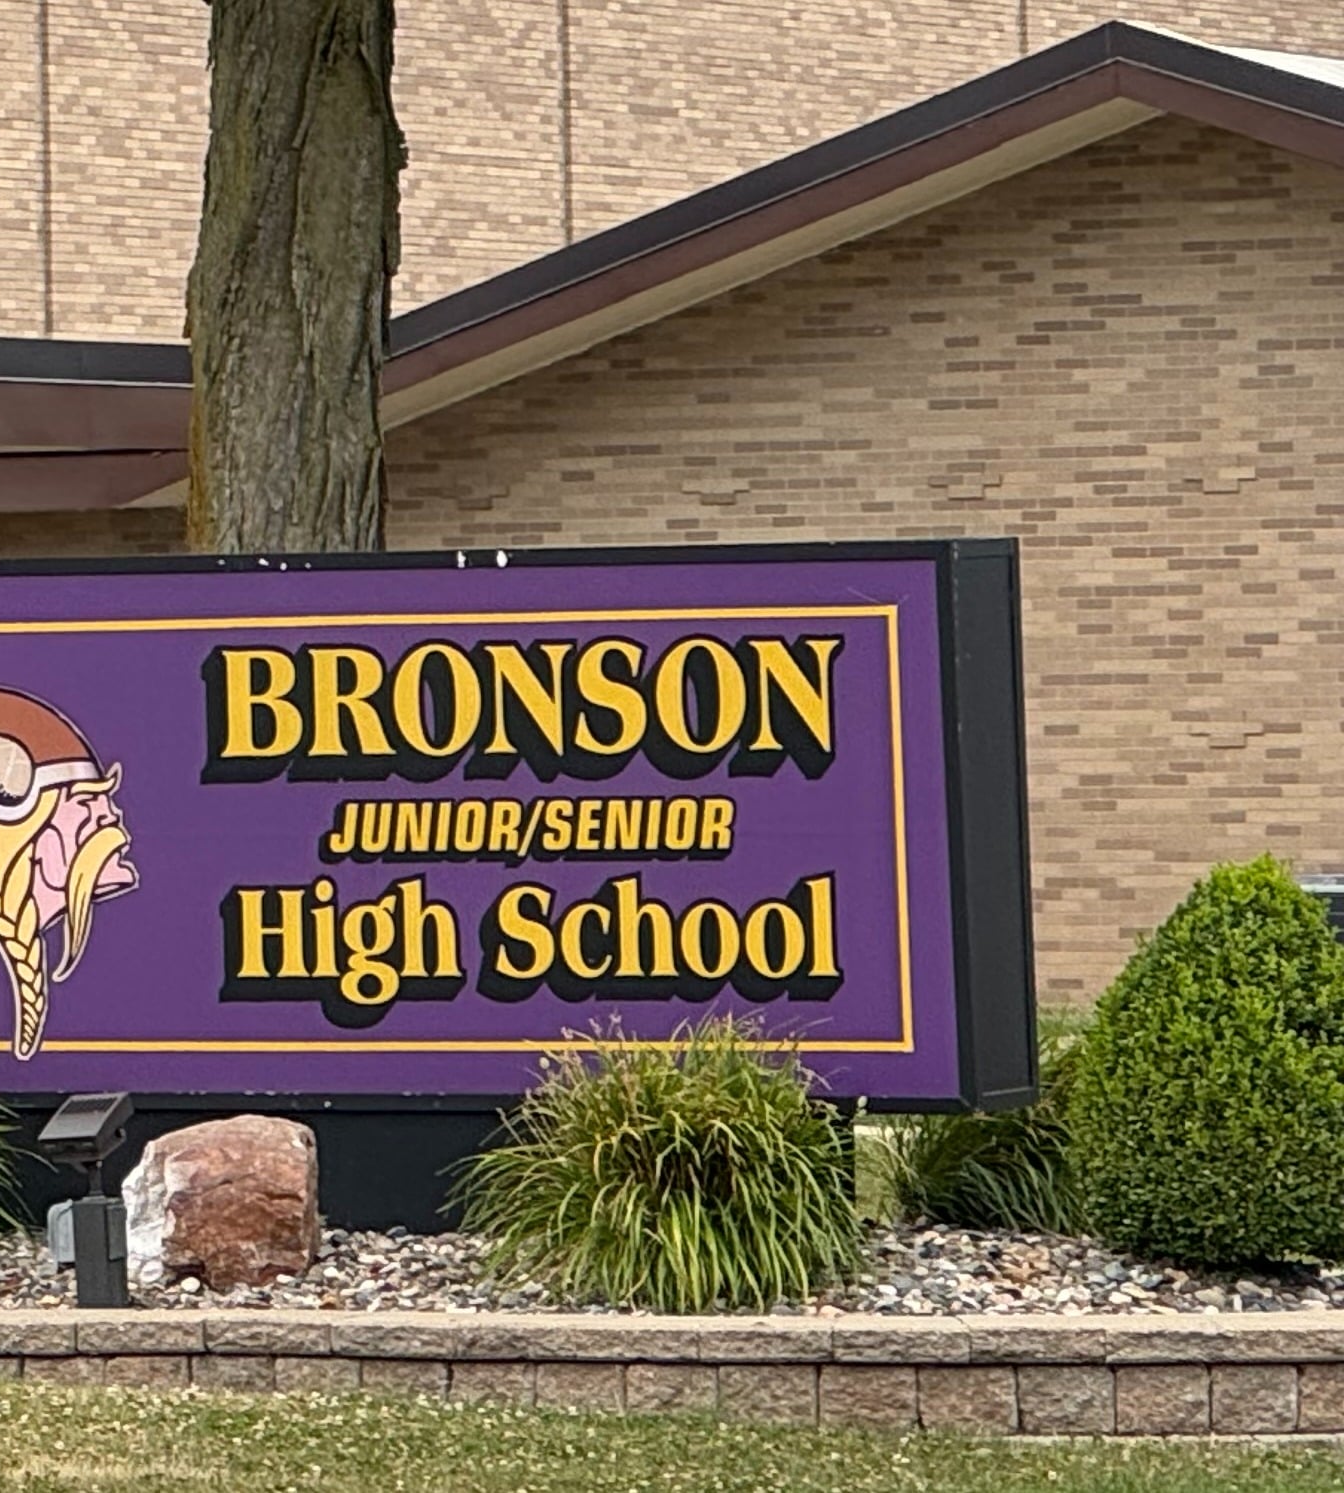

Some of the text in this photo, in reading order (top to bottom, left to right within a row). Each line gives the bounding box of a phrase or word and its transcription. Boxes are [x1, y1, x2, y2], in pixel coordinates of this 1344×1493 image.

[221, 639, 837, 759] BRONSON
[328, 798, 734, 855] JUNIOR/SENIOR
[237, 876, 838, 1005] High School
